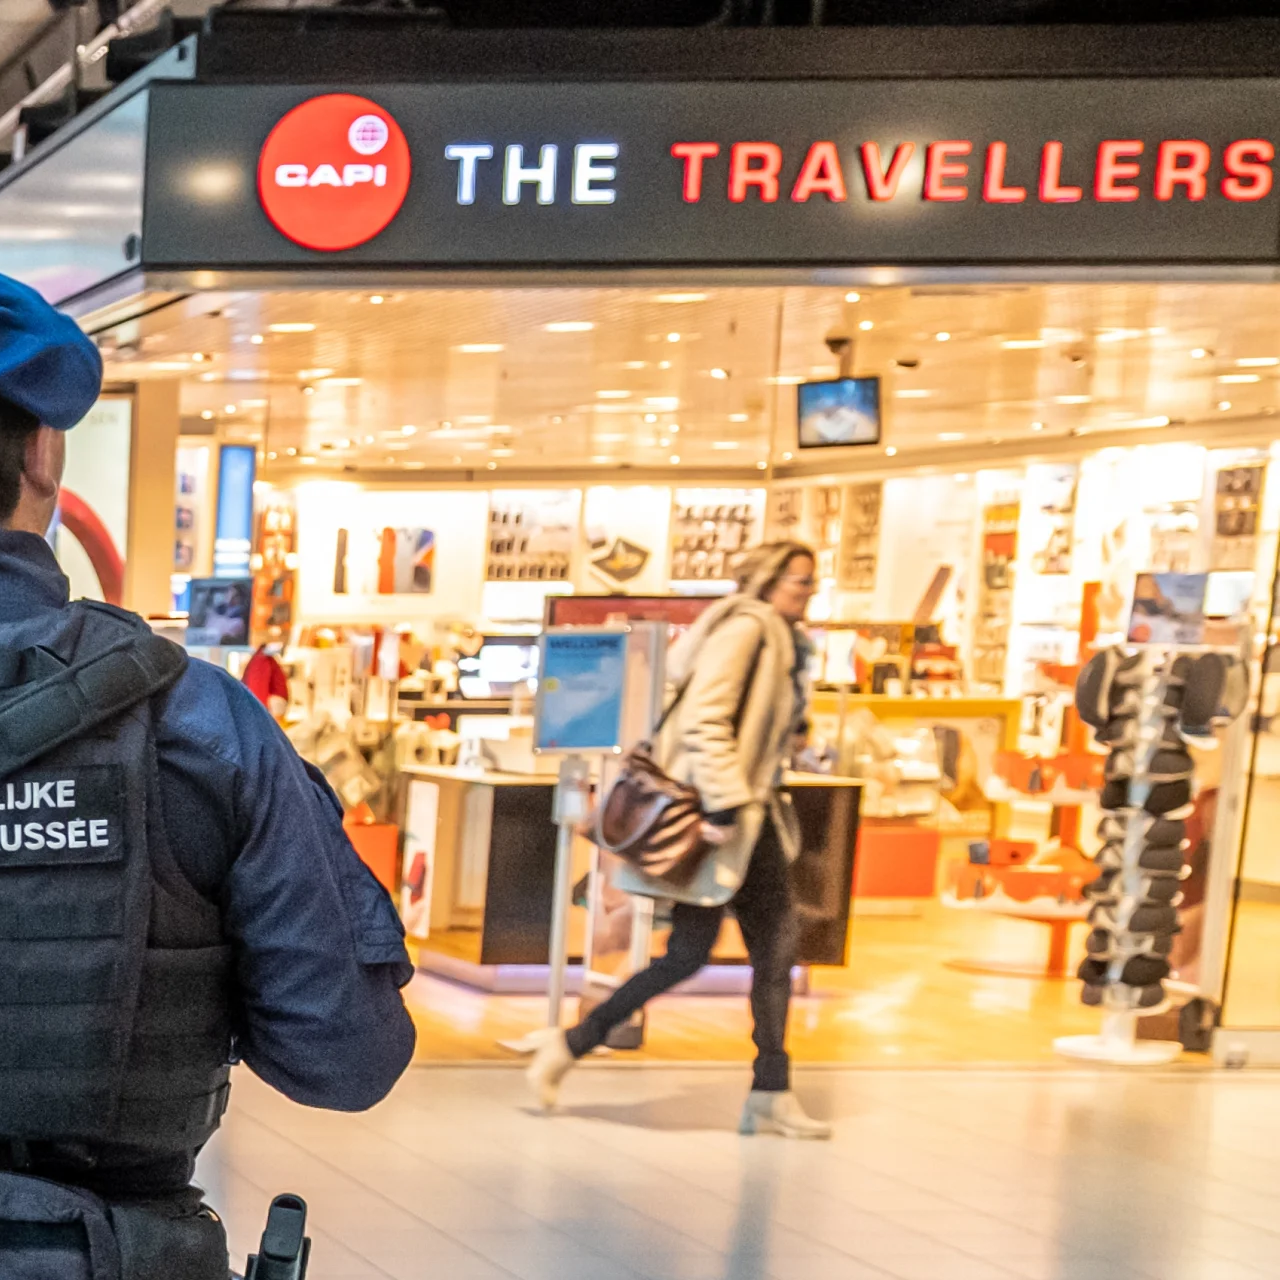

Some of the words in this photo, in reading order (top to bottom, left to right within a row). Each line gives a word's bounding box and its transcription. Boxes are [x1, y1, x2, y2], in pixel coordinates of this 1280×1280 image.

[274, 164, 388, 188] CAPI
[444, 142, 620, 206] THE
[670, 138, 1277, 204] TRAVELLERS
